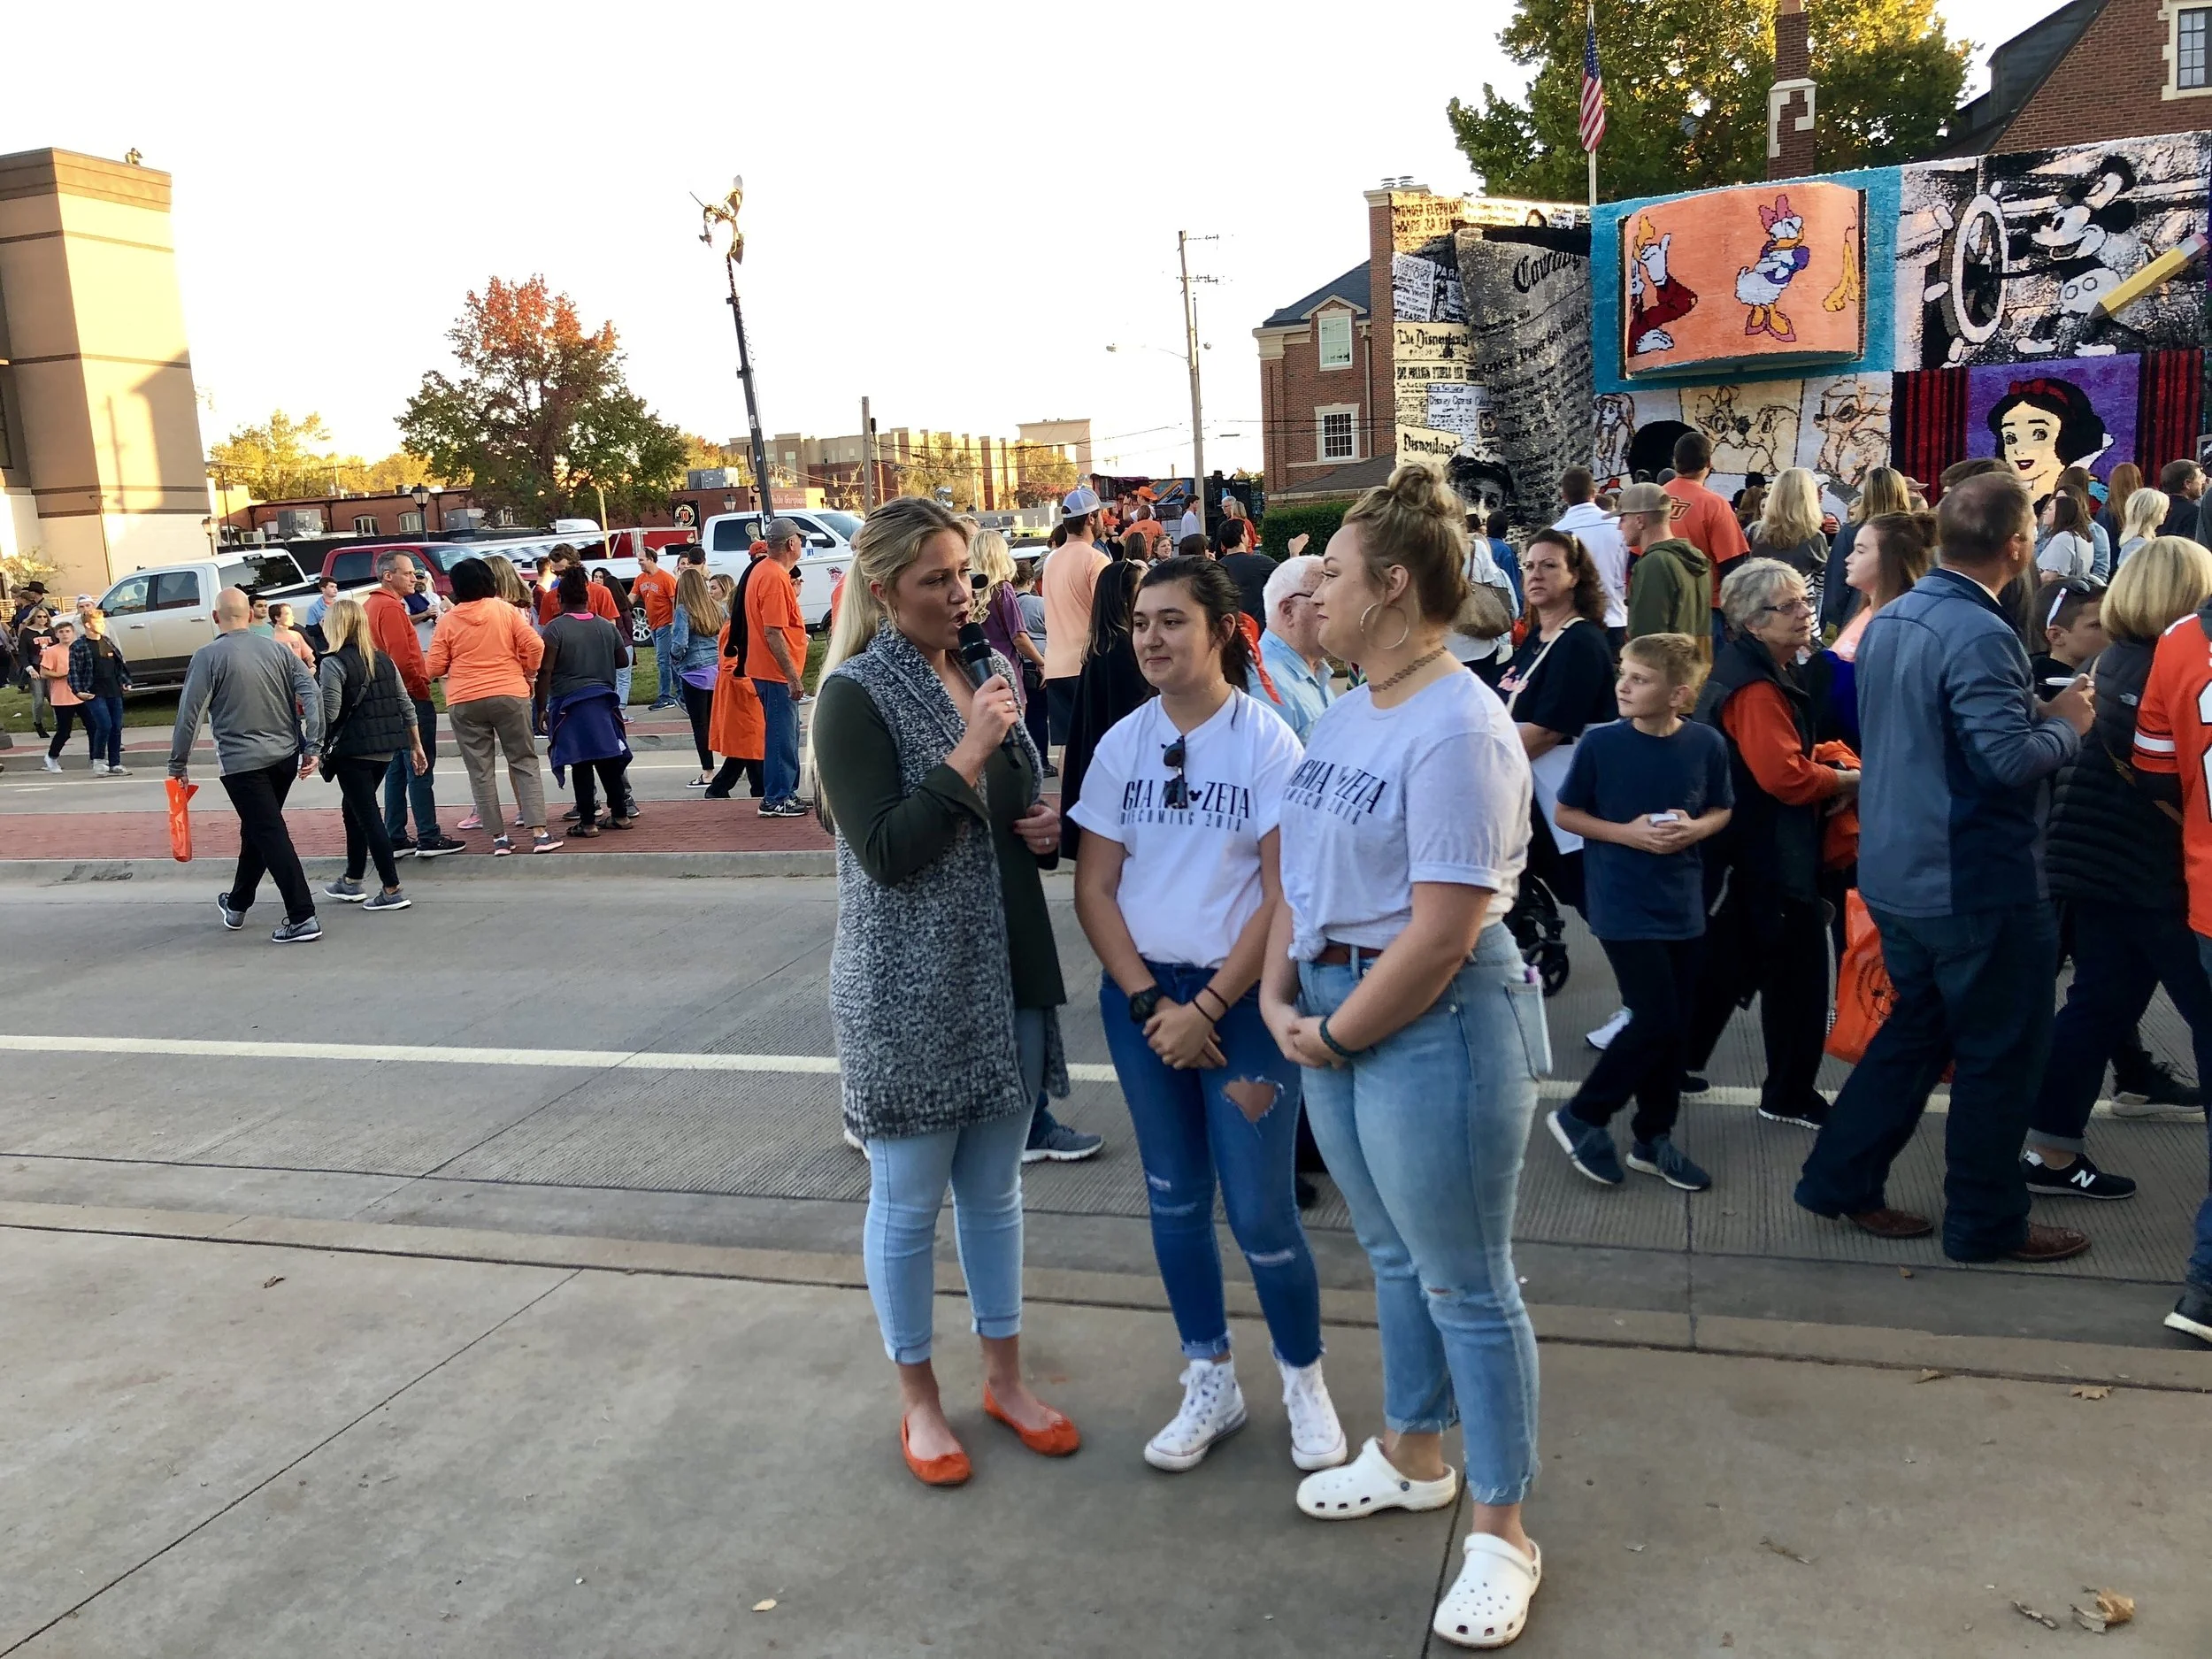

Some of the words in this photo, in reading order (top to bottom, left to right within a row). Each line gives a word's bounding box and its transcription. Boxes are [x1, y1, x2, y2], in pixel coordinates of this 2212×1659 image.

[1397, 328, 1414, 345] The
[1403, 433, 1458, 457] Disneyland
[1202, 780, 1249, 818] ZETA
[1334, 768, 1387, 814] ZETA
[2070, 1169, 2097, 1188] N
